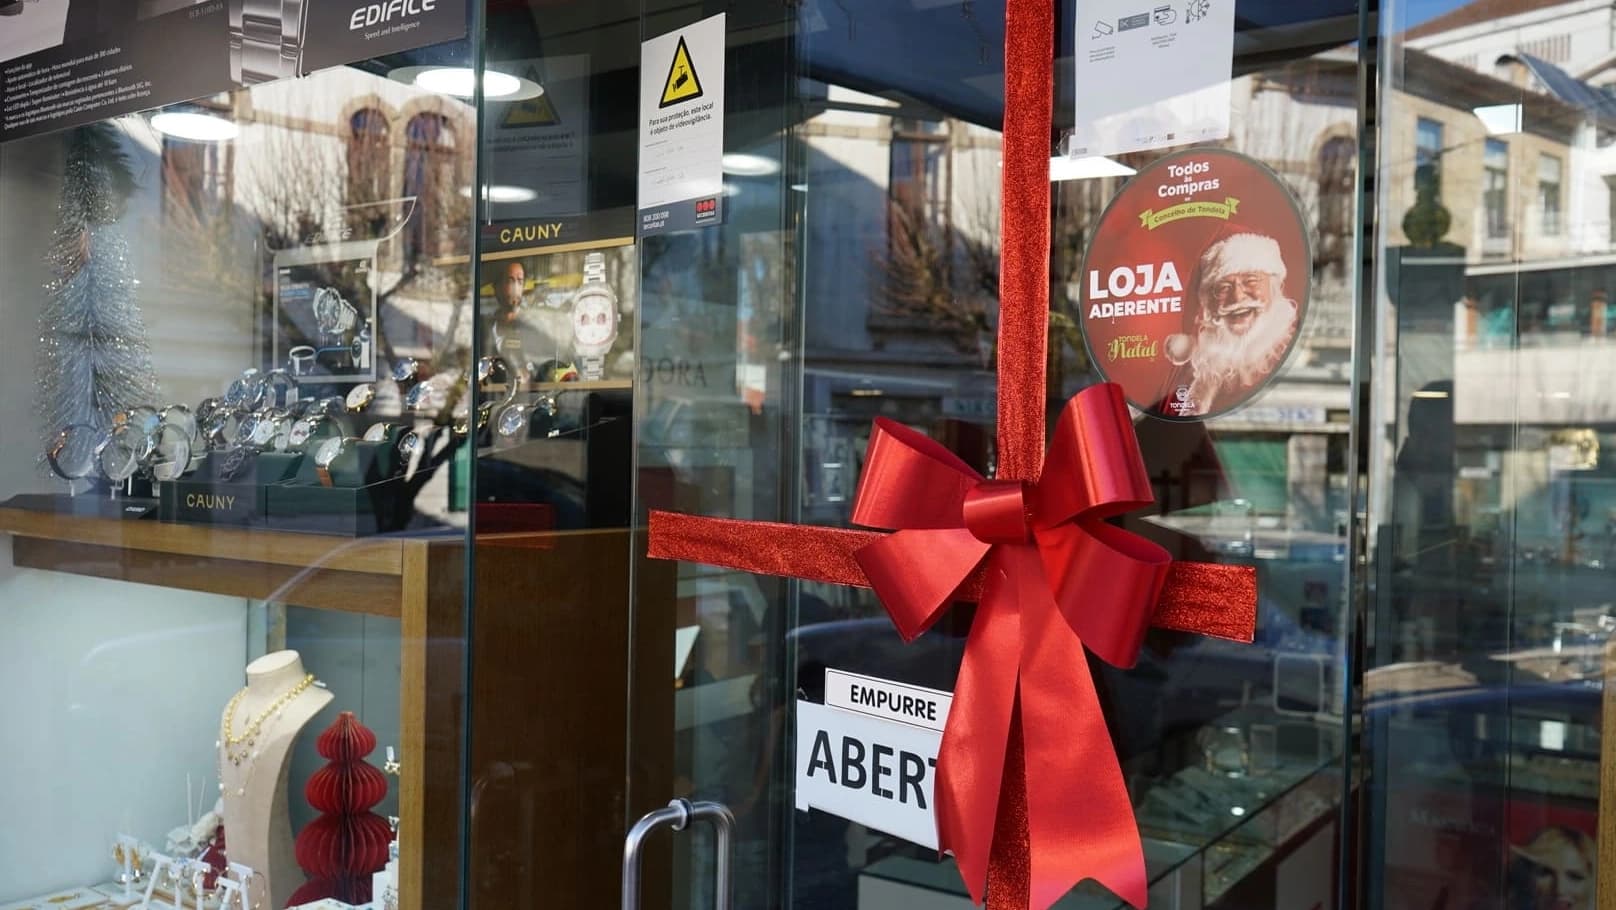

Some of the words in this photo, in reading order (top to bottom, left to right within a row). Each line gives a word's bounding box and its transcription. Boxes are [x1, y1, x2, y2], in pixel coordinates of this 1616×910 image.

[349, 0, 435, 30] EDIFICE
[1167, 161, 1209, 177] Todos
[1157, 178, 1219, 198] Compras
[1197, 205, 1225, 214] Tondela
[500, 222, 562, 244] CAUNY
[1089, 262, 1183, 300] LOJA
[1089, 297, 1182, 319] ADERENTE
[1107, 339, 1158, 361] Natal
[186, 493, 235, 511] CAUNY
[850, 684, 937, 721] EMPURRE
[806, 729, 938, 810] ABER
